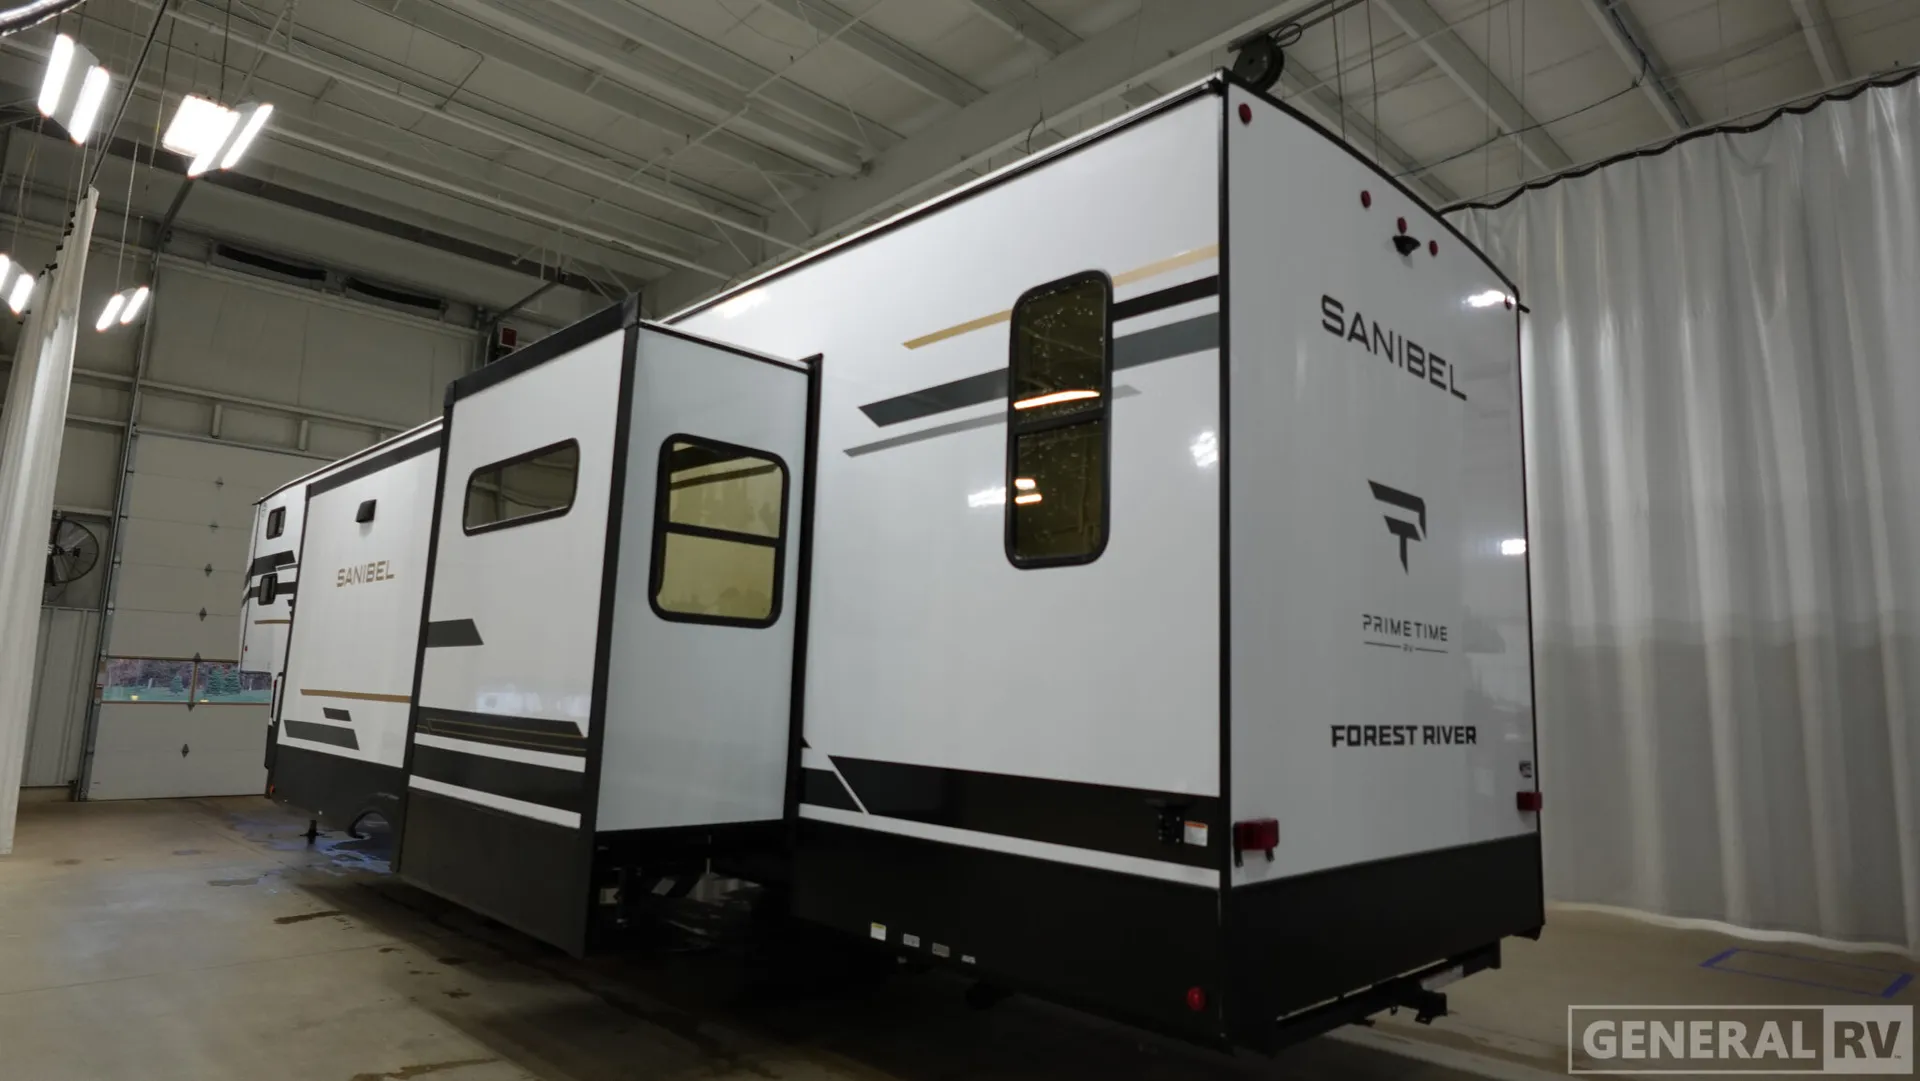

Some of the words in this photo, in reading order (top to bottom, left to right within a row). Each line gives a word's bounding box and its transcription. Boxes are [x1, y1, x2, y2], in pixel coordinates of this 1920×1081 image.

[1321, 294, 1467, 401] SANIBEL
[336, 560, 395, 587] SANIBEL
[1331, 725, 1418, 747] FOREST
[1423, 725, 1477, 745] RIVER
